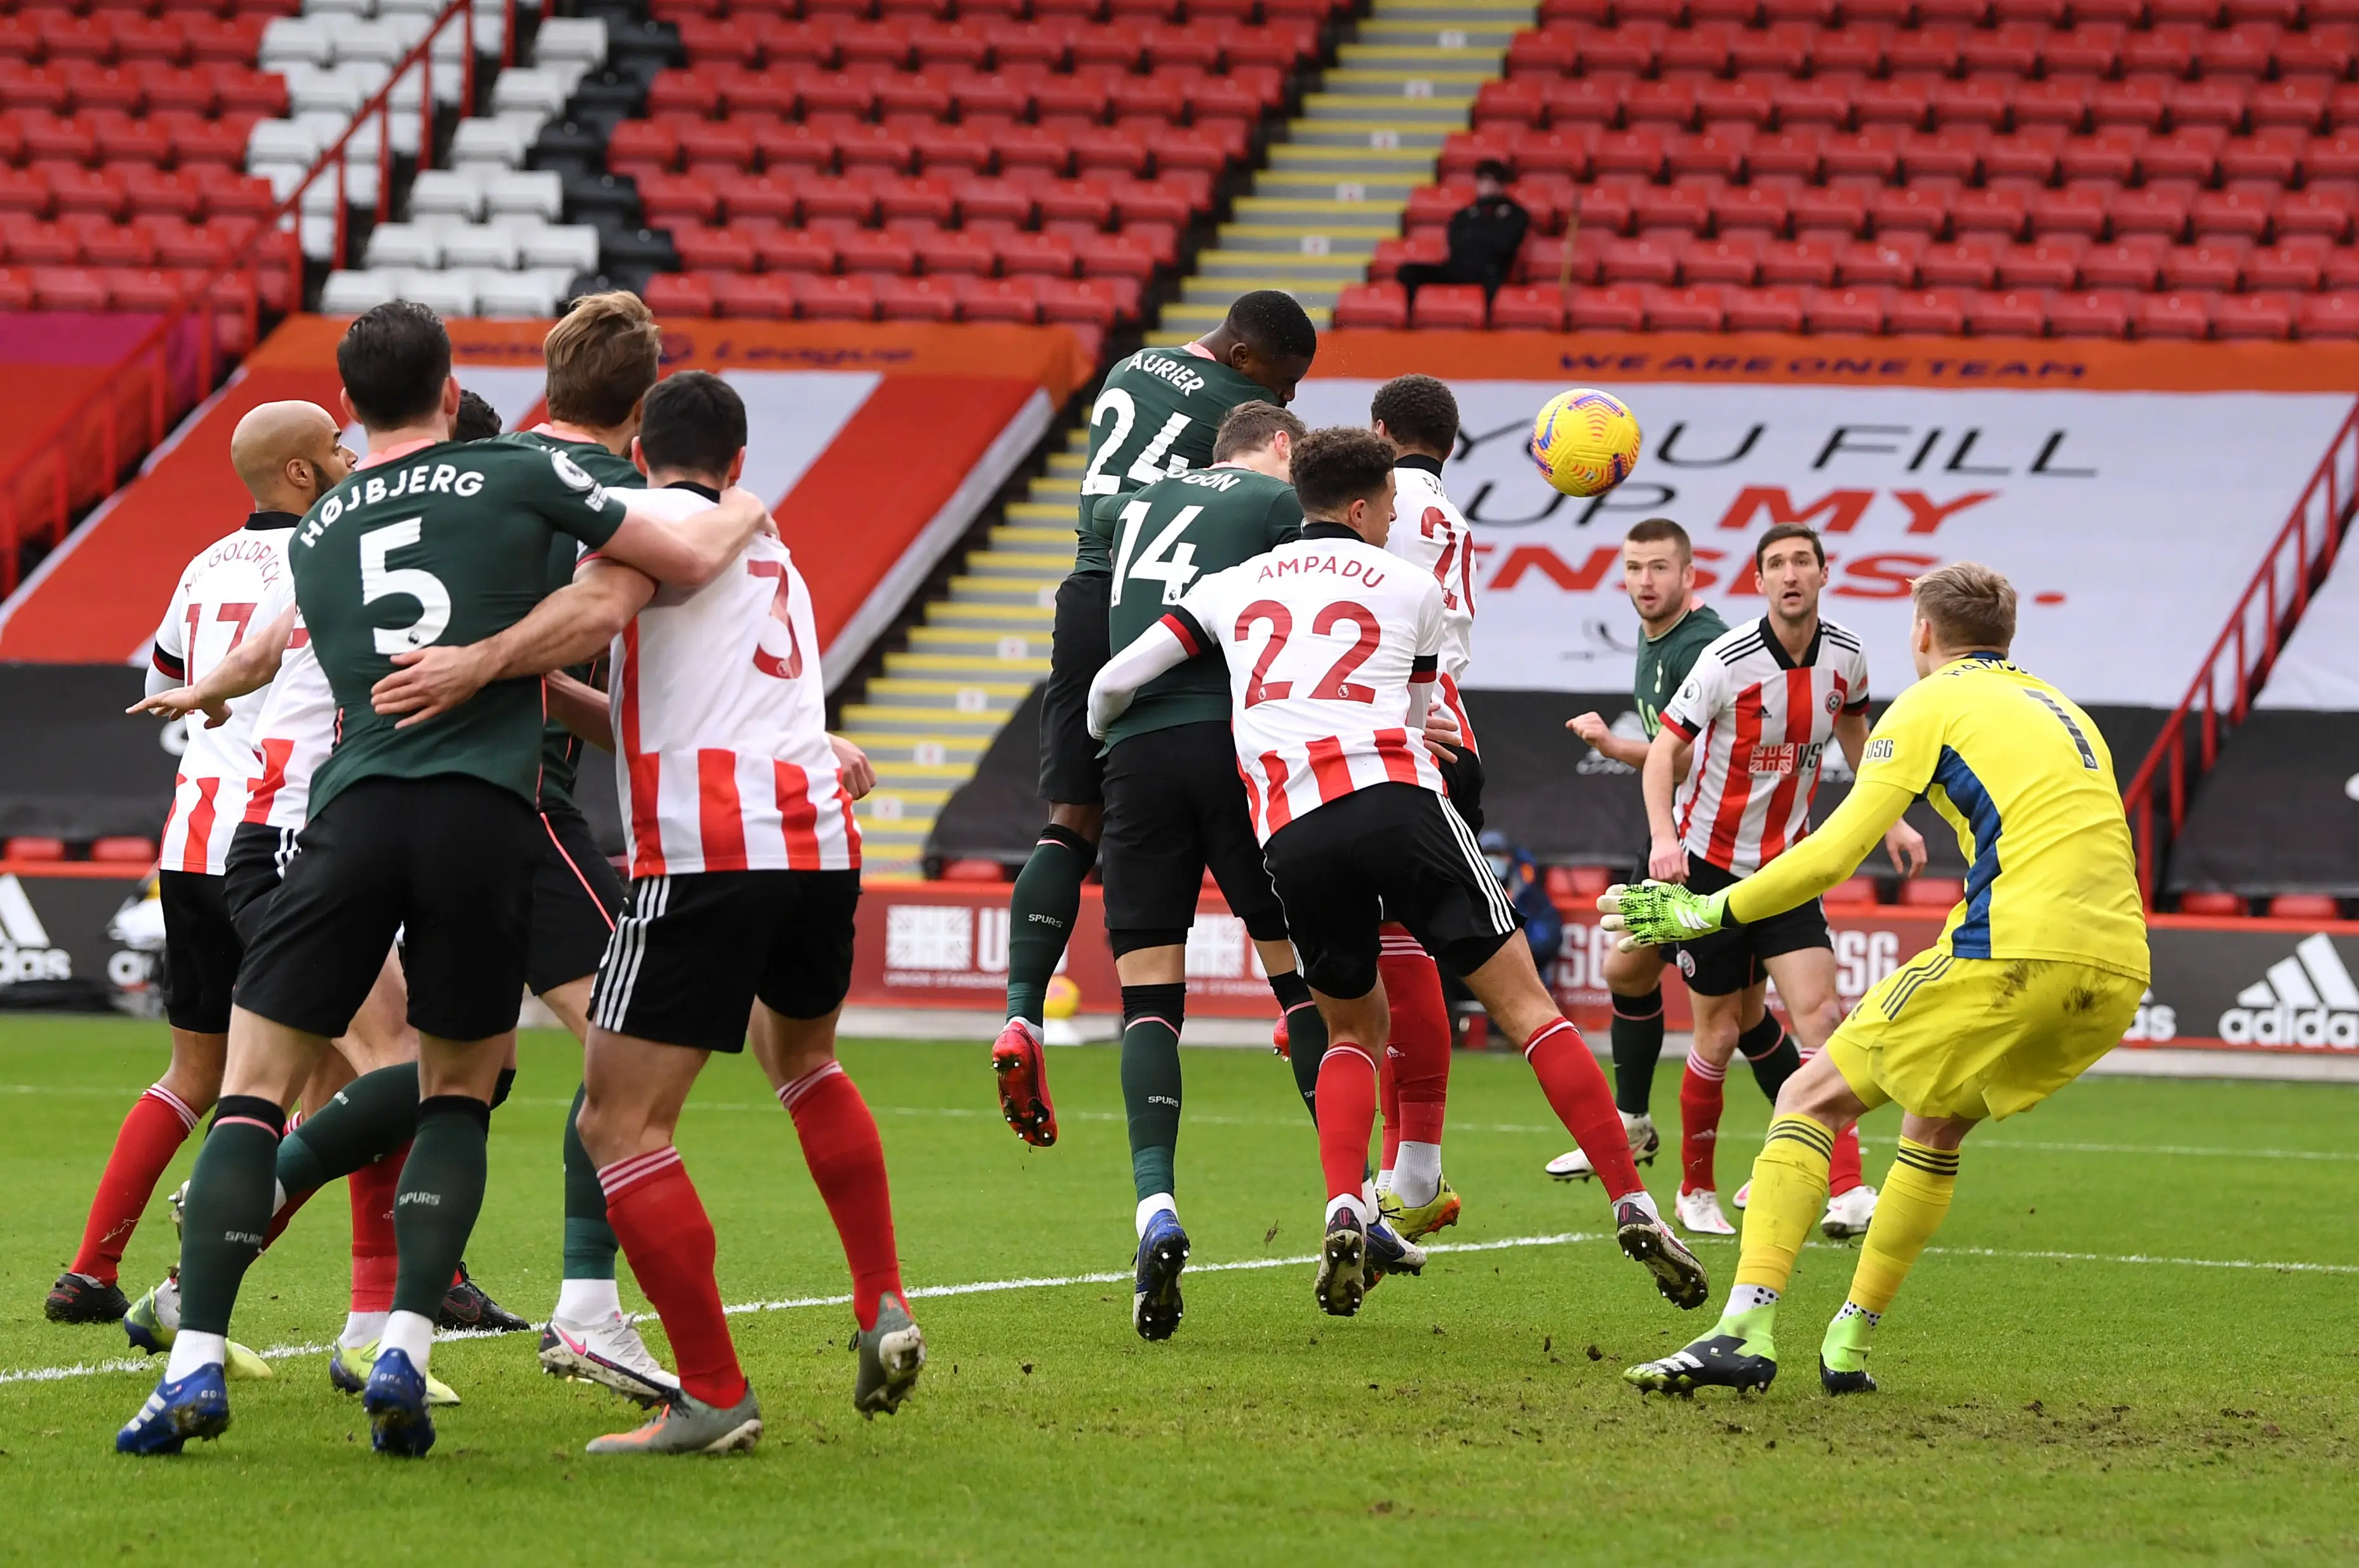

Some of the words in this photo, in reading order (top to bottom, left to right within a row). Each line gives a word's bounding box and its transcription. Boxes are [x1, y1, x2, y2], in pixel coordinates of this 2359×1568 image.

[1124, 352, 1204, 397] AURIER
[1559, 352, 1651, 370] WE
[1661, 354, 1776, 372] ARE
[1786, 356, 1908, 374] ONE
[1926, 358, 2087, 377] TEAM
[1081, 388, 1192, 495] 24
[1453, 418, 1766, 467] YU
[1810, 425, 2099, 478] FILL
[300, 464, 485, 547] HØJBJERG
[1463, 480, 1678, 527] UP
[1717, 485, 2002, 534] MY
[1110, 500, 1200, 608] 14
[1258, 556, 1385, 588] AMPADU
[360, 516, 452, 654] 5
[747, 558, 803, 680] 3
[185, 603, 259, 714] 17
[1234, 600, 1381, 710] 22
[1866, 739, 1894, 759] USG
[2023, 688, 2099, 770] 1
[1028, 913, 1063, 928] SPURS
[1827, 930, 1900, 996] SG
[1148, 1096, 1179, 1108] SPURS
[399, 1191, 441, 1205] SPURS
[224, 1231, 264, 1244] SPURS
